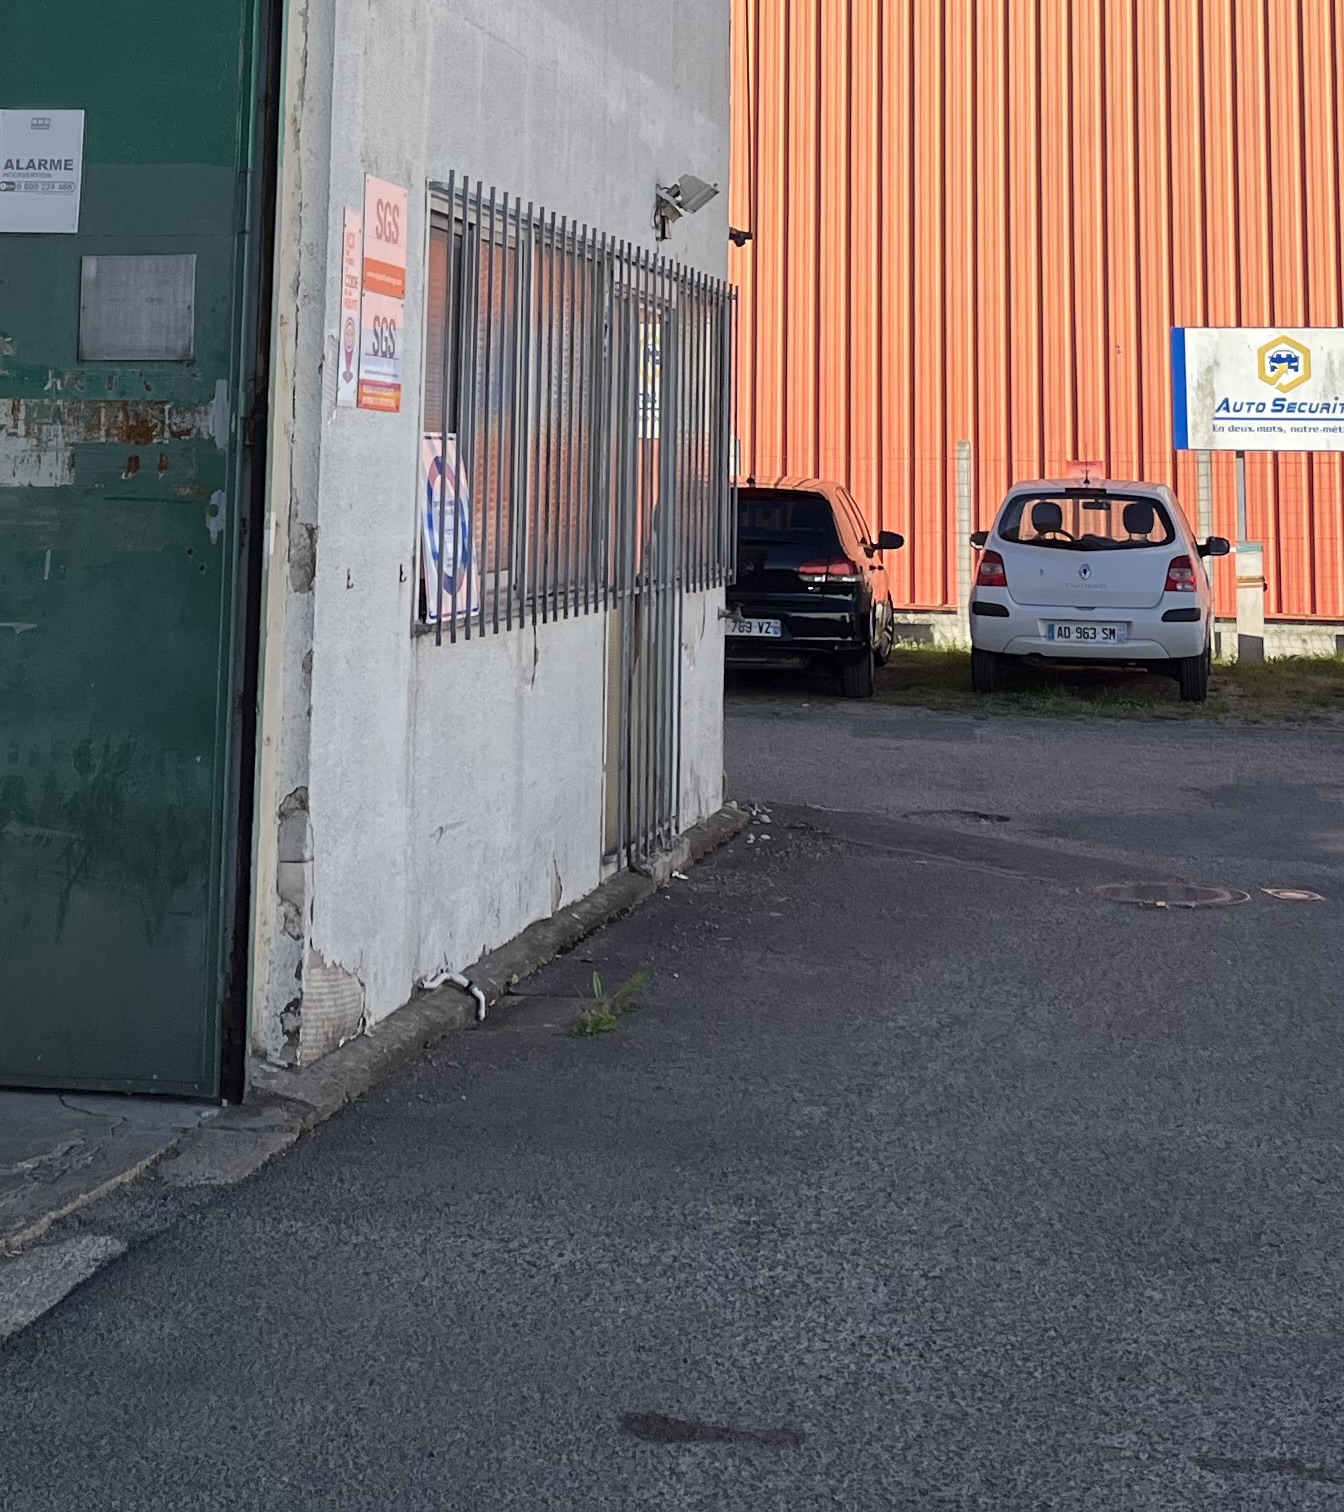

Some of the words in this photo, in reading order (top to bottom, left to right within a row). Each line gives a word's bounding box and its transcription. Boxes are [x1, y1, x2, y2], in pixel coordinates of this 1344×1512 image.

[3, 158, 74, 171] ALARME
[376, 198, 400, 246] SGS
[372, 314, 397, 359] SGS
[1215, 397, 1267, 414] AUTO
[1212, 424, 1225, 433] En
[1290, 425, 1320, 434] notre
